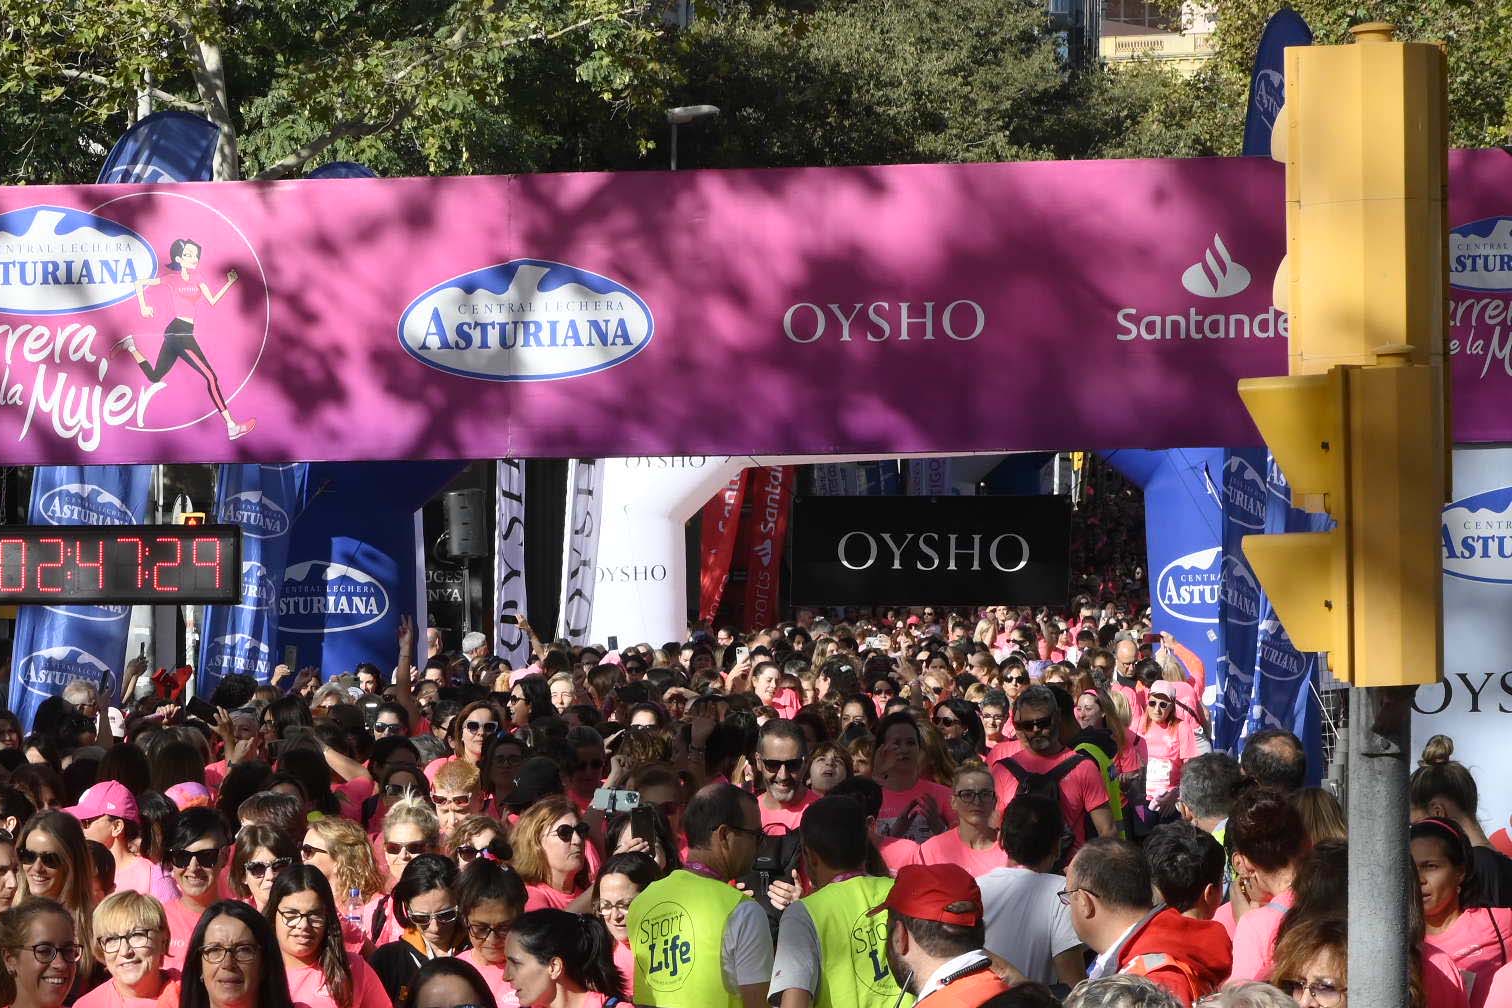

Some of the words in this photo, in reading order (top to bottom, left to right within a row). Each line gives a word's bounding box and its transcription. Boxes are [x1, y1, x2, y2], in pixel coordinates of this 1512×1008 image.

[457, 302, 536, 315] CENTRAL
[544, 301, 626, 313] LECHERA
[782, 299, 985, 344] OYSHO
[1115, 306, 1288, 341] Santande
[418, 306, 634, 351] ASTURIANA
[1466, 327, 1483, 354] la
[0, 367, 24, 406] la
[18, 359, 167, 452] Mujer
[836, 530, 1031, 574] OYSHO
[278, 595, 380, 616] STURIANA
[326, 585, 376, 593] LECHERA
[640, 911, 685, 945] Sport
[853, 922, 889, 954] Spo
[648, 934, 692, 977] Life
